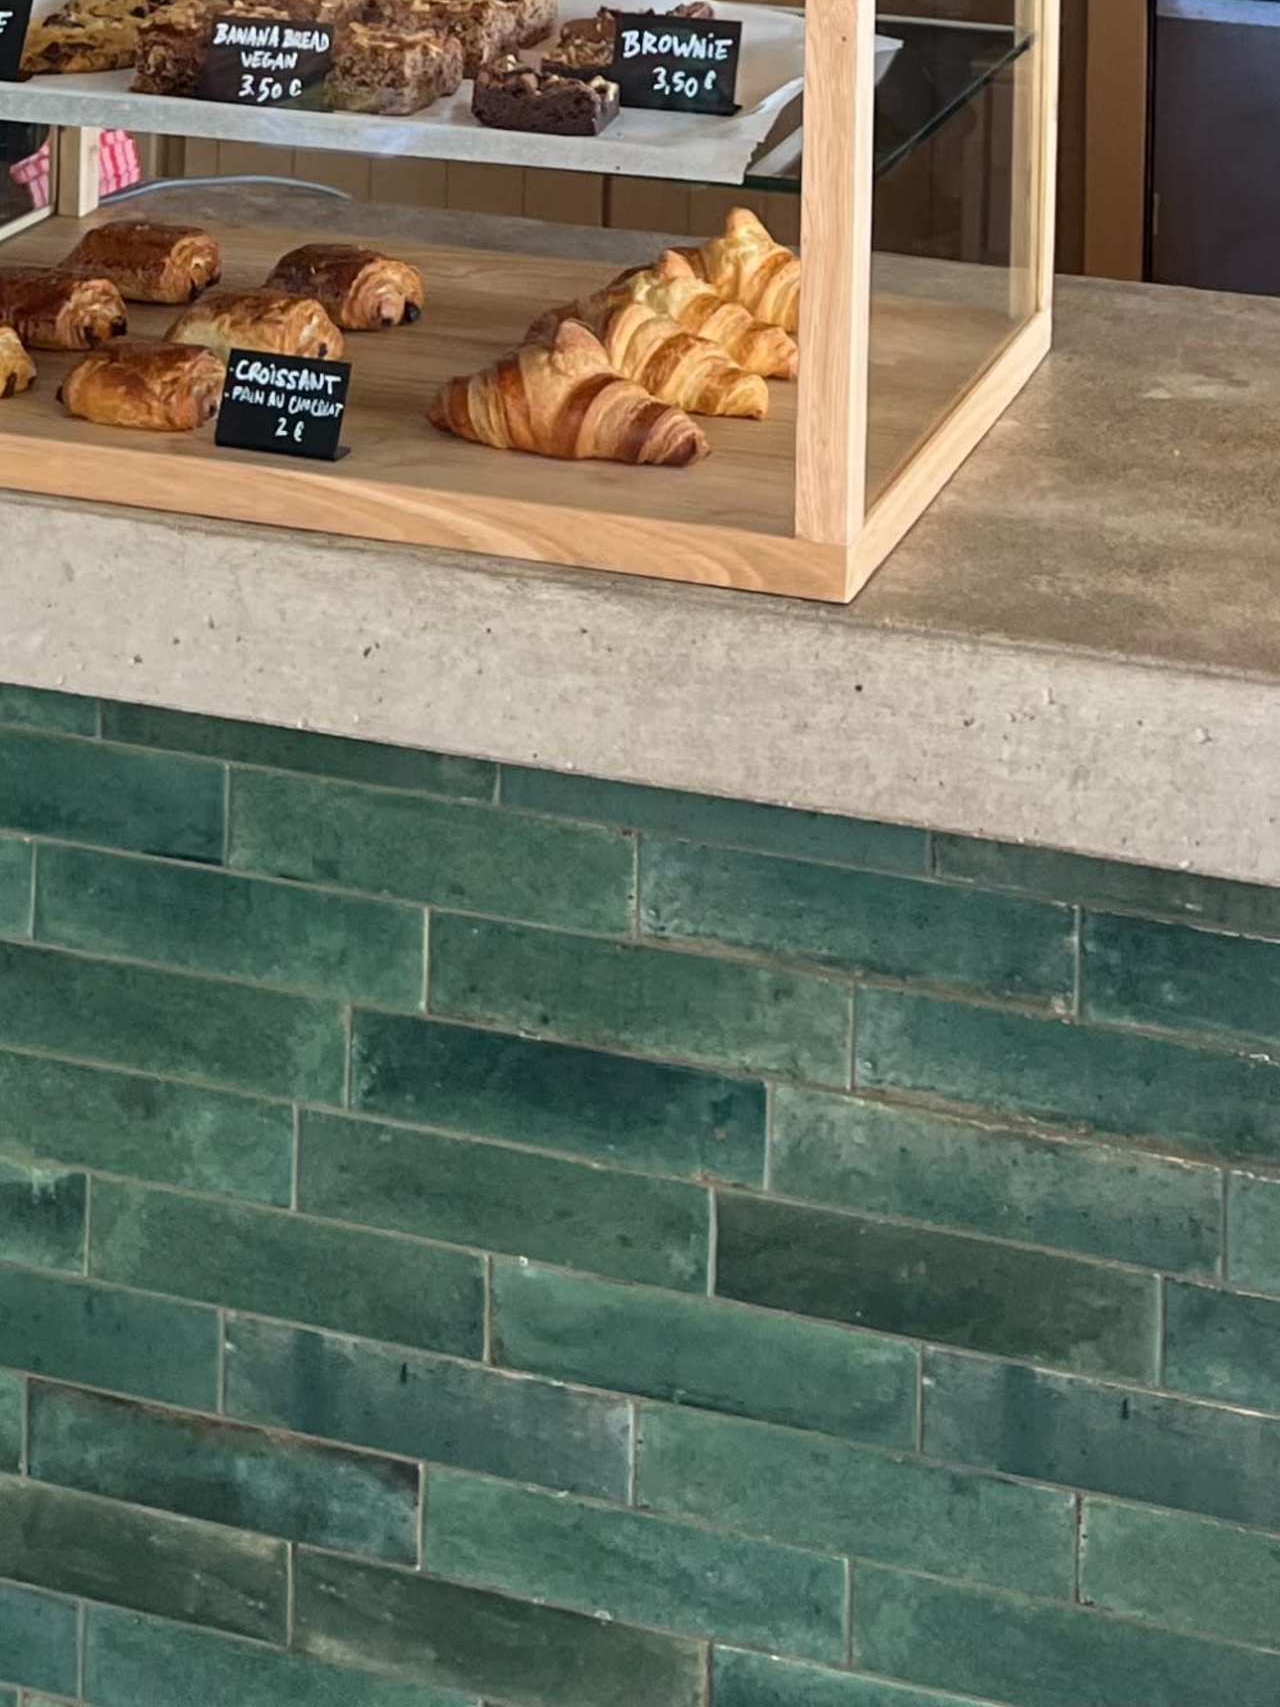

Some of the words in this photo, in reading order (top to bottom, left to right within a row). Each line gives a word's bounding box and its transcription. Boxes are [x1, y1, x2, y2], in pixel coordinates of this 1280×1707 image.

[213, 23, 281, 48] BANANA
[283, 29, 330, 53] BREAD
[240, 50, 298, 70] VEGAN
[235, 358, 342, 396] CROISSANT
[231, 385, 265, 406] PAIN
[266, 389, 286, 410] AU
